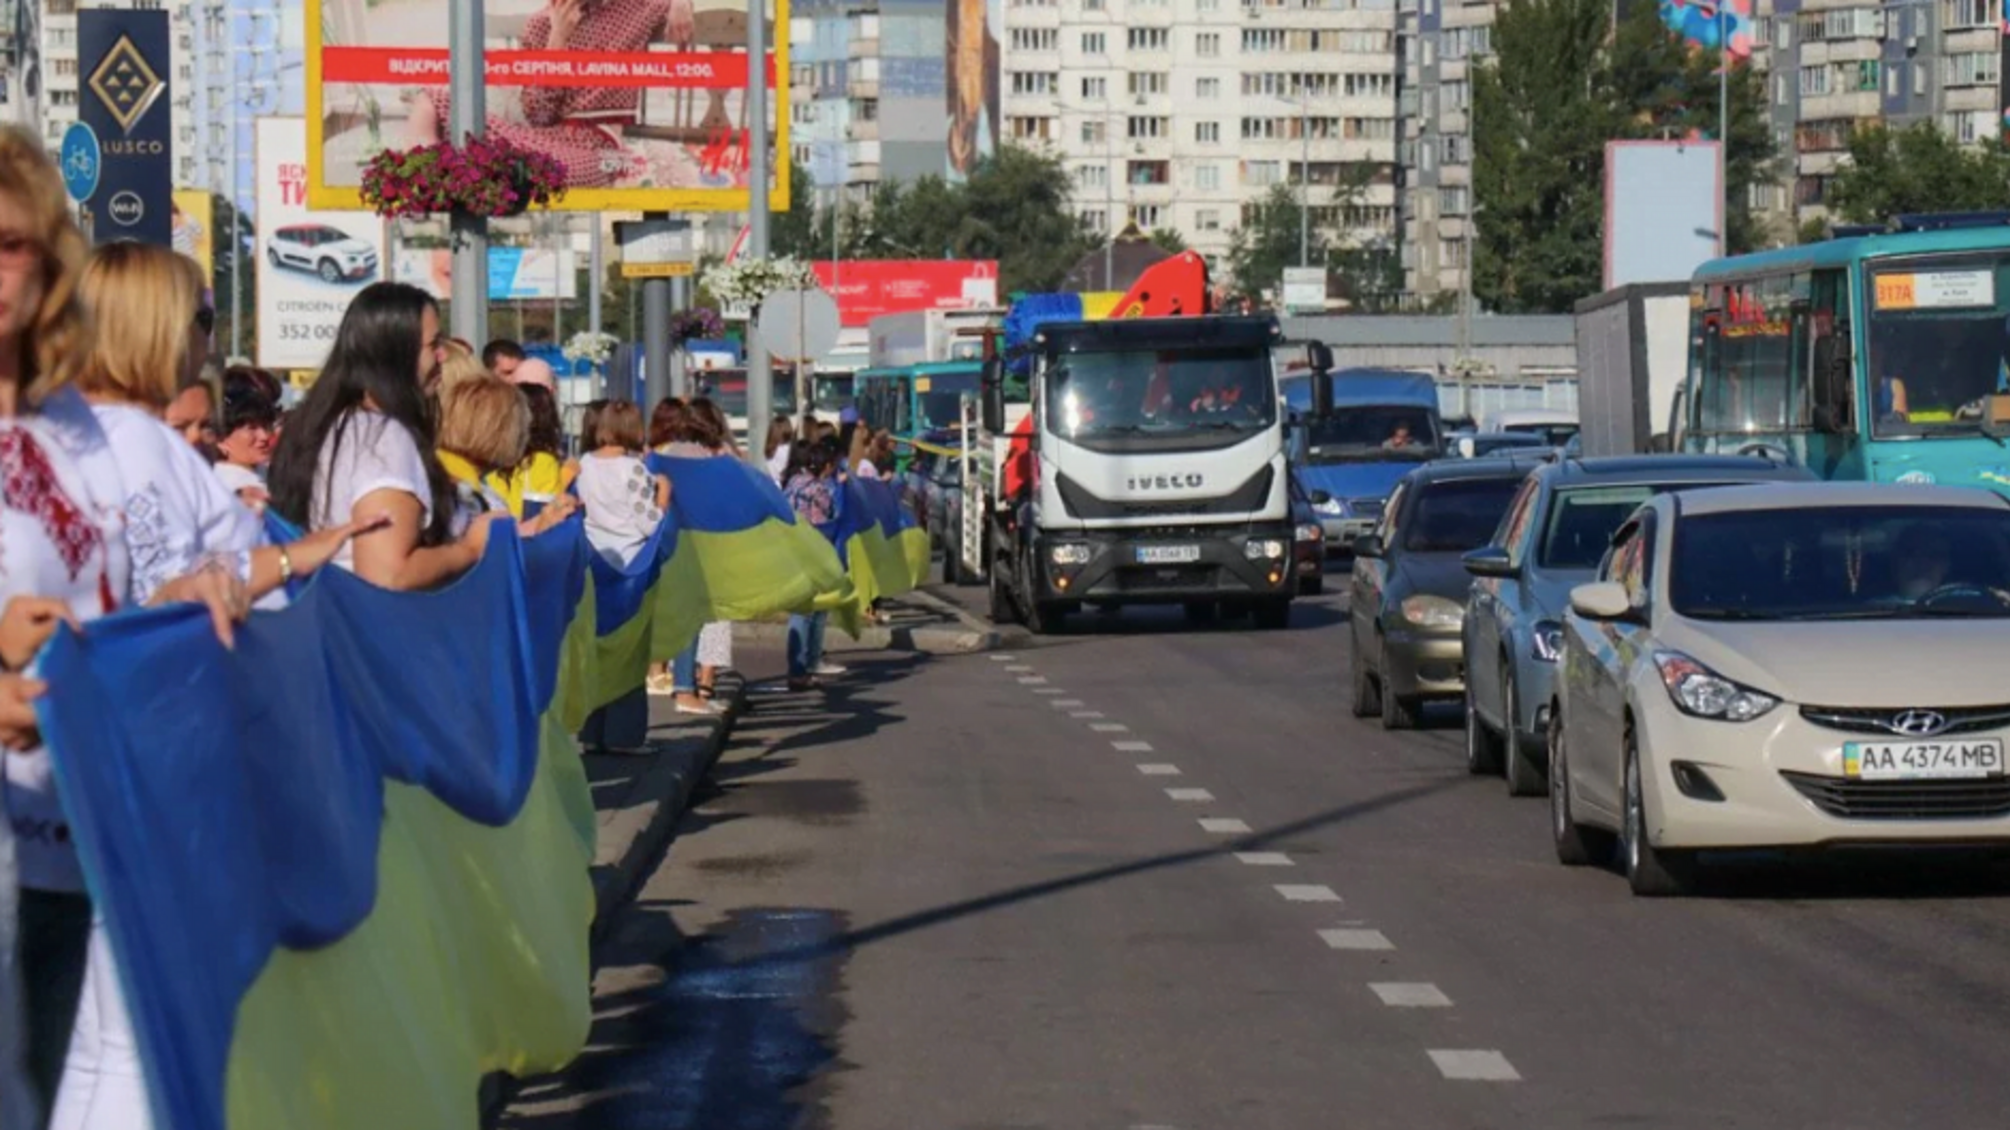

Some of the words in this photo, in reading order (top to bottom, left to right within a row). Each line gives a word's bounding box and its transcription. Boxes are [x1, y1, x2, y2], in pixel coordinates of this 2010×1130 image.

[388, 58, 451, 74] ВІДКРИТ
[512, 59, 575, 77] СЕРПНЯ,
[577, 61, 629, 76] LAVINA
[631, 62, 674, 78] MALL,
[103, 140, 164, 154] LUSCO
[337, 301, 348, 313] C
[278, 324, 311, 341] 352
[313, 324, 339, 341] 00
[1127, 473, 1203, 491] IVECO
[1862, 746, 1897, 770] AA
[1901, 745, 1957, 769] 4374
[1961, 744, 1997, 768] MB
